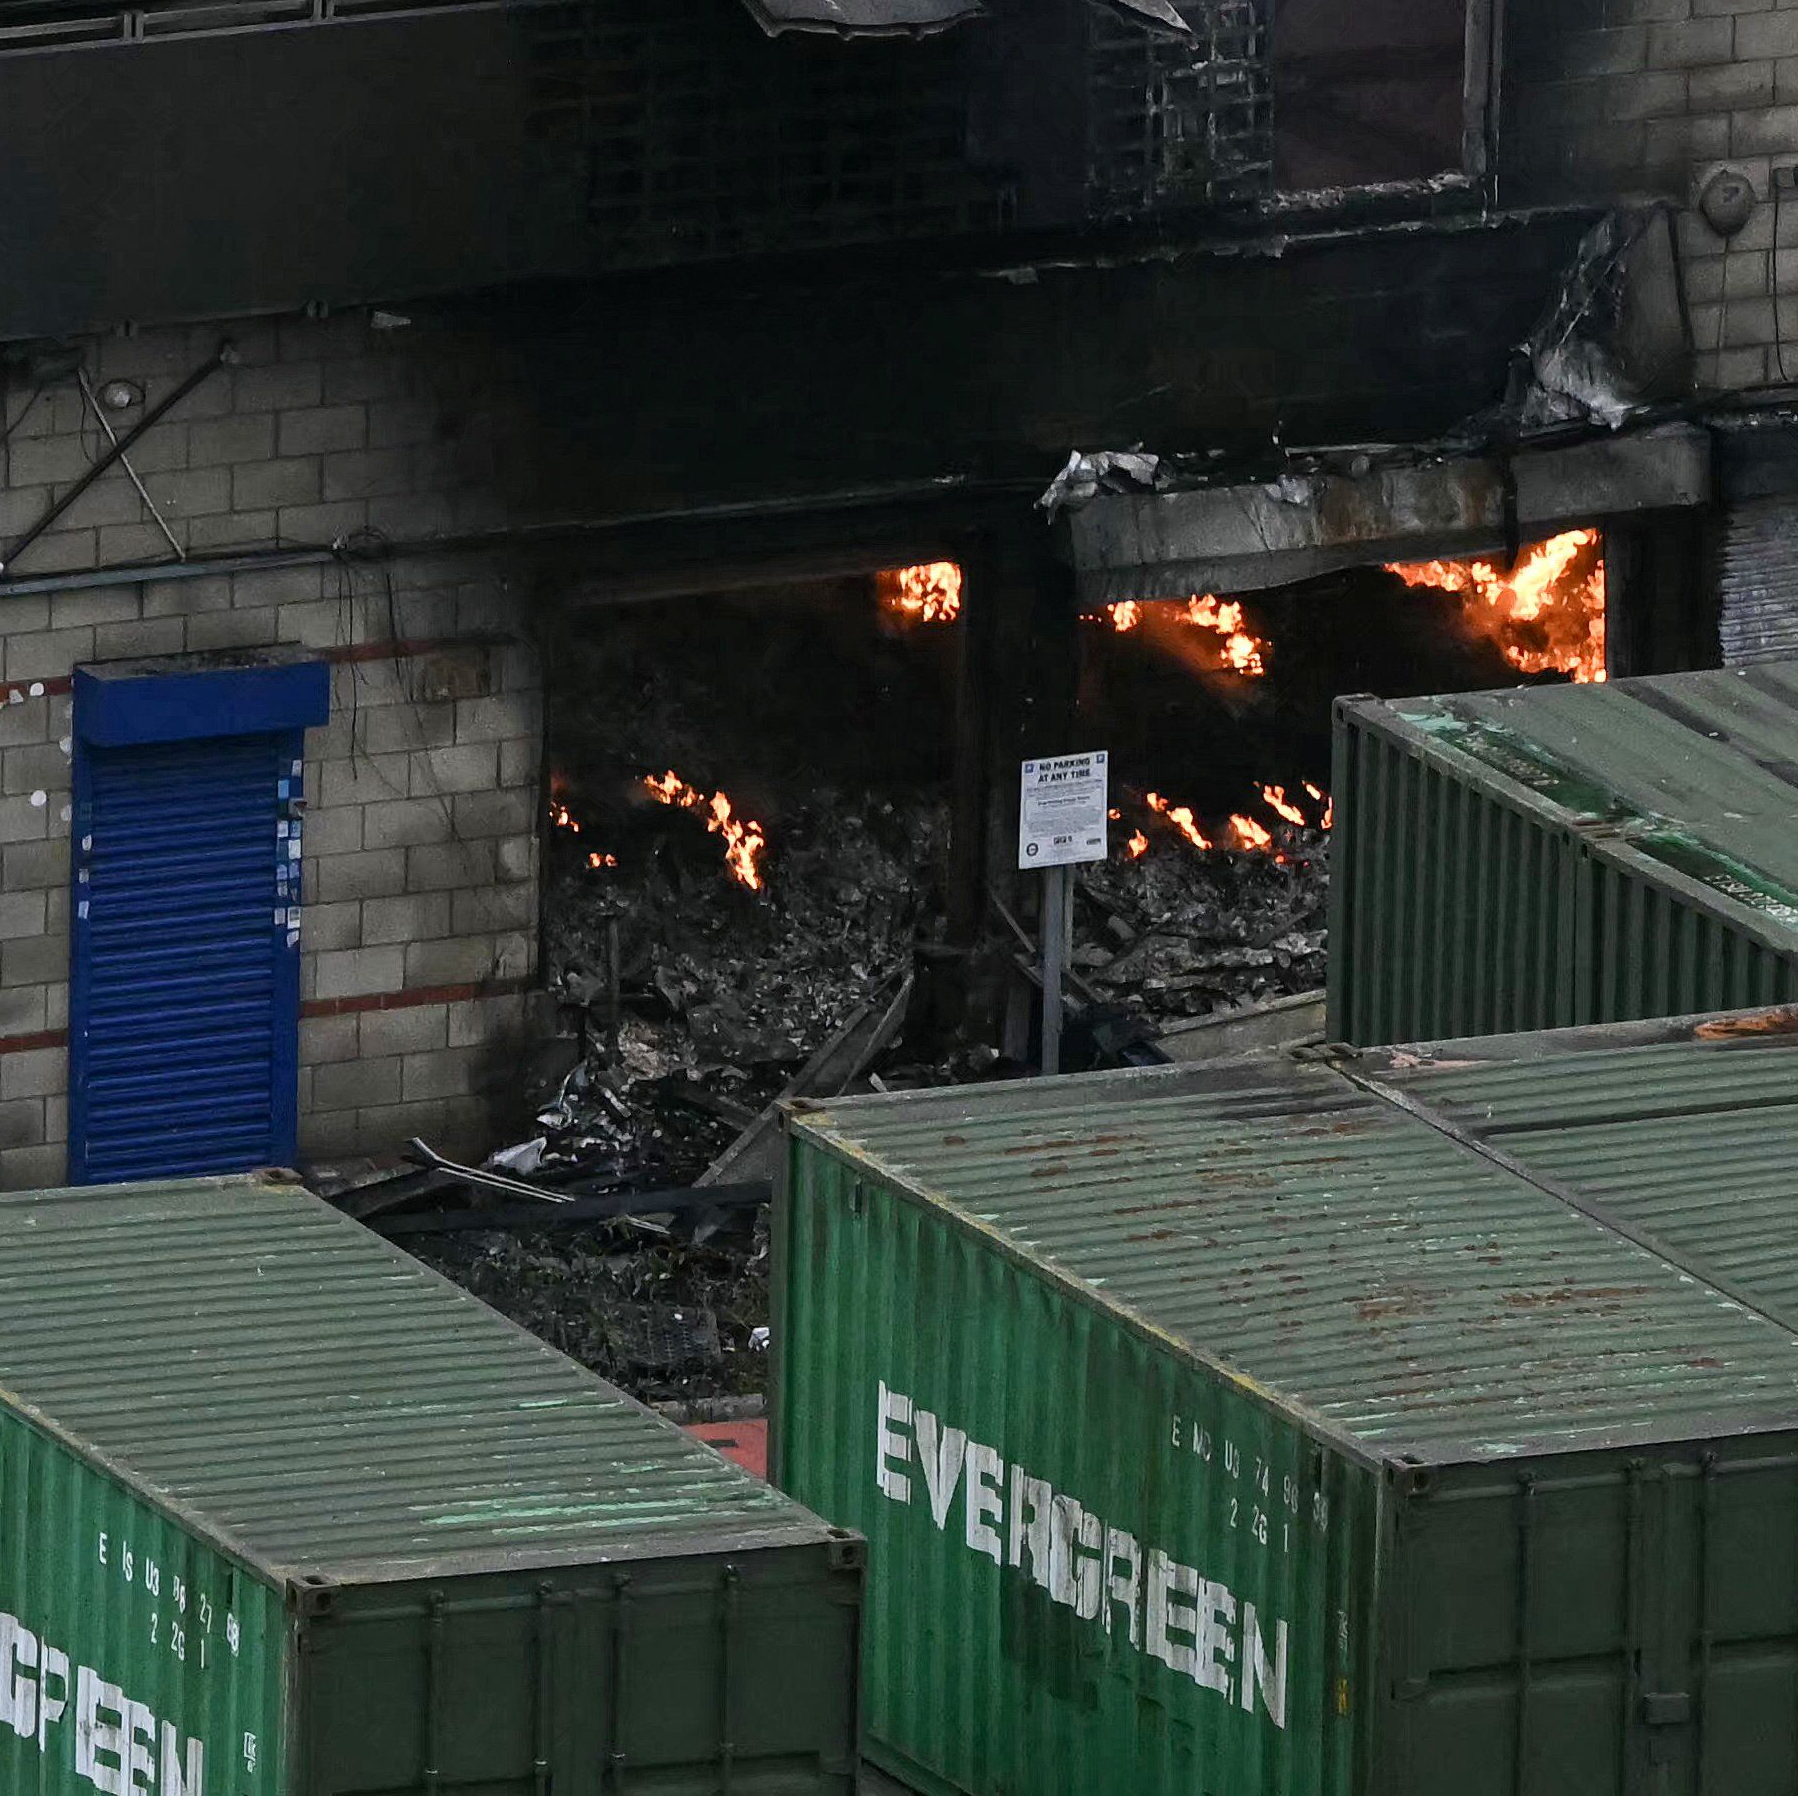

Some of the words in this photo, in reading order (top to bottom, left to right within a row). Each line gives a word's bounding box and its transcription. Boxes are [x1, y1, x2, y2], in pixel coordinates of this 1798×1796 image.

[1039, 762, 1052, 772] NO
[1053, 757, 1091, 770] PARKING
[1038, 773, 1049, 784] AT
[1050, 771, 1069, 782] ANY
[1071, 768, 1091, 779] TIME
[876, 1379, 1288, 1729] EVERGREEN
